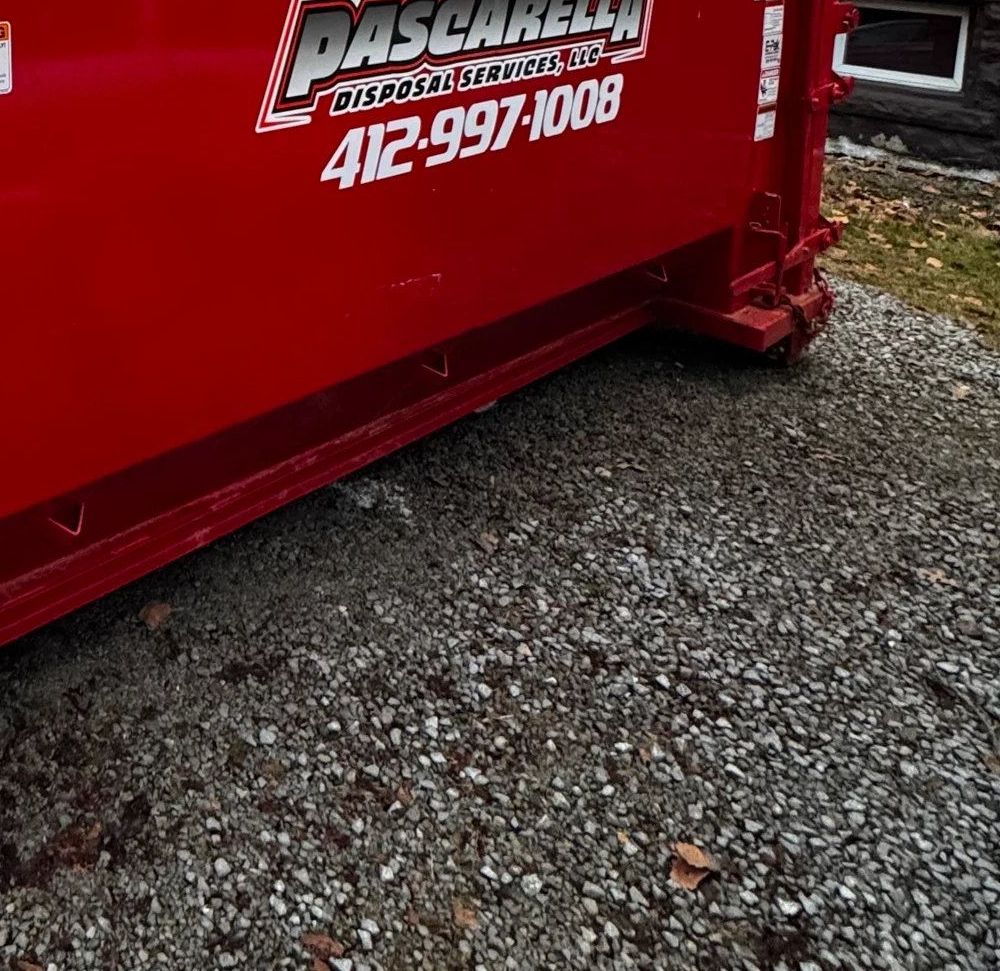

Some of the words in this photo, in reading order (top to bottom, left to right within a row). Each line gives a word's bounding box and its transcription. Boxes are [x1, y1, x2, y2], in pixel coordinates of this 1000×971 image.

[333, 72, 452, 112] DISPOSAL
[460, 54, 564, 90] SERVICES,
[570, 44, 601, 68] LLC
[320, 74, 624, 190] 412-997-1008
